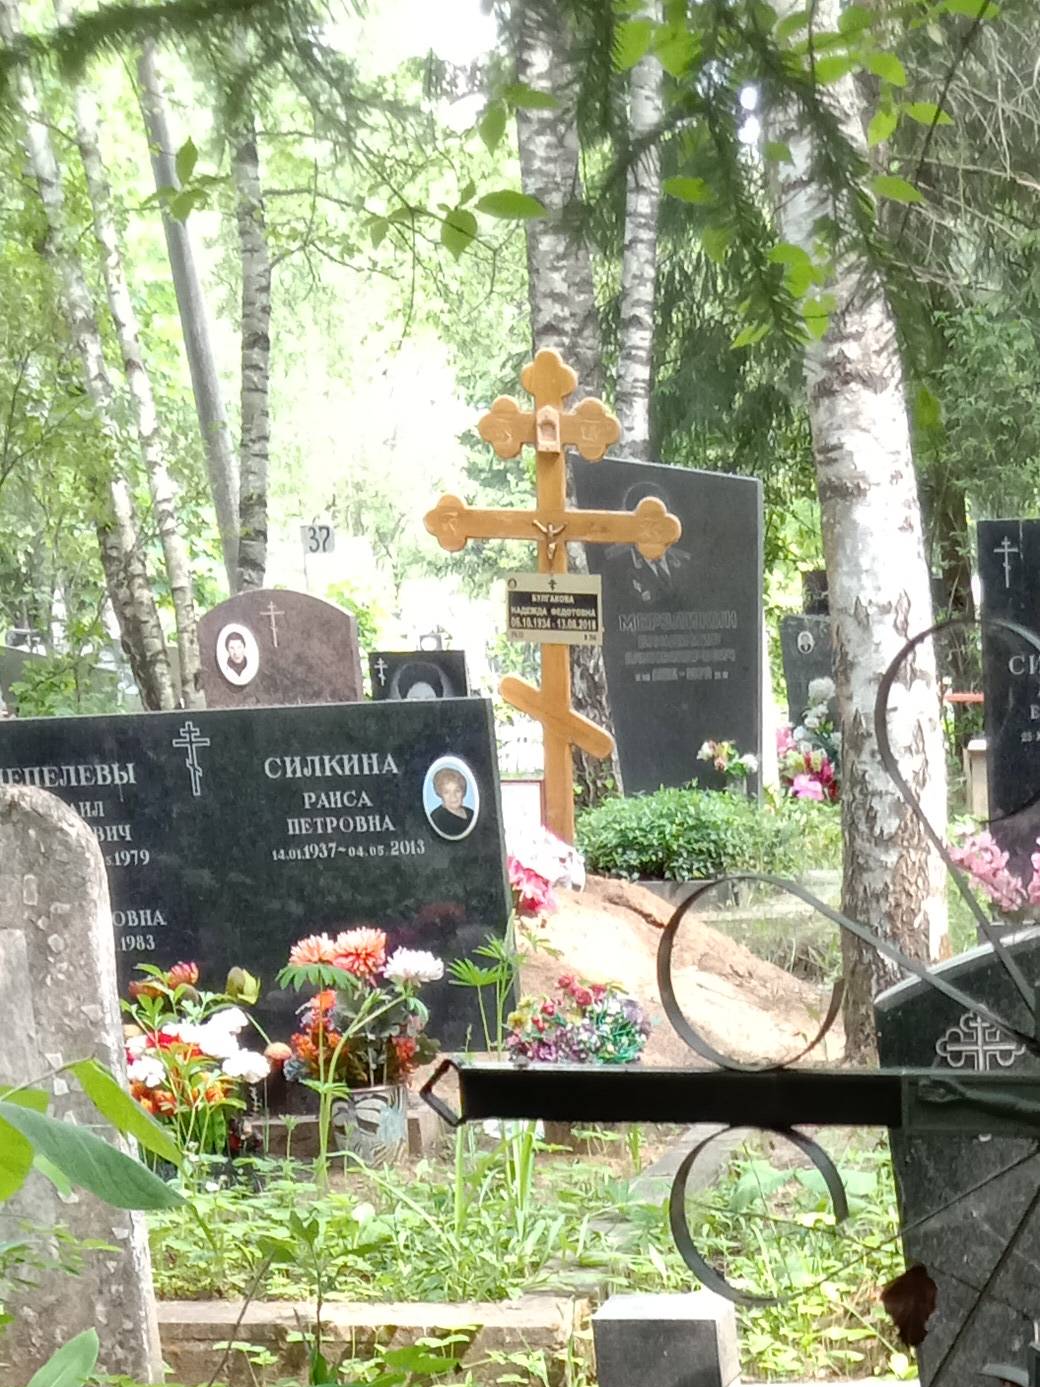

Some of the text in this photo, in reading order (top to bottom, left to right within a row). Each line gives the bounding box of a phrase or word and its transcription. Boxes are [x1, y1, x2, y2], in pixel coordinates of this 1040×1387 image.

[308, 525, 330, 553] 37
[264, 753, 399, 779] СИЛКИНА
[303, 790, 374, 809] РАИСА
[286, 814, 396, 835] ПЕТРОВНА
